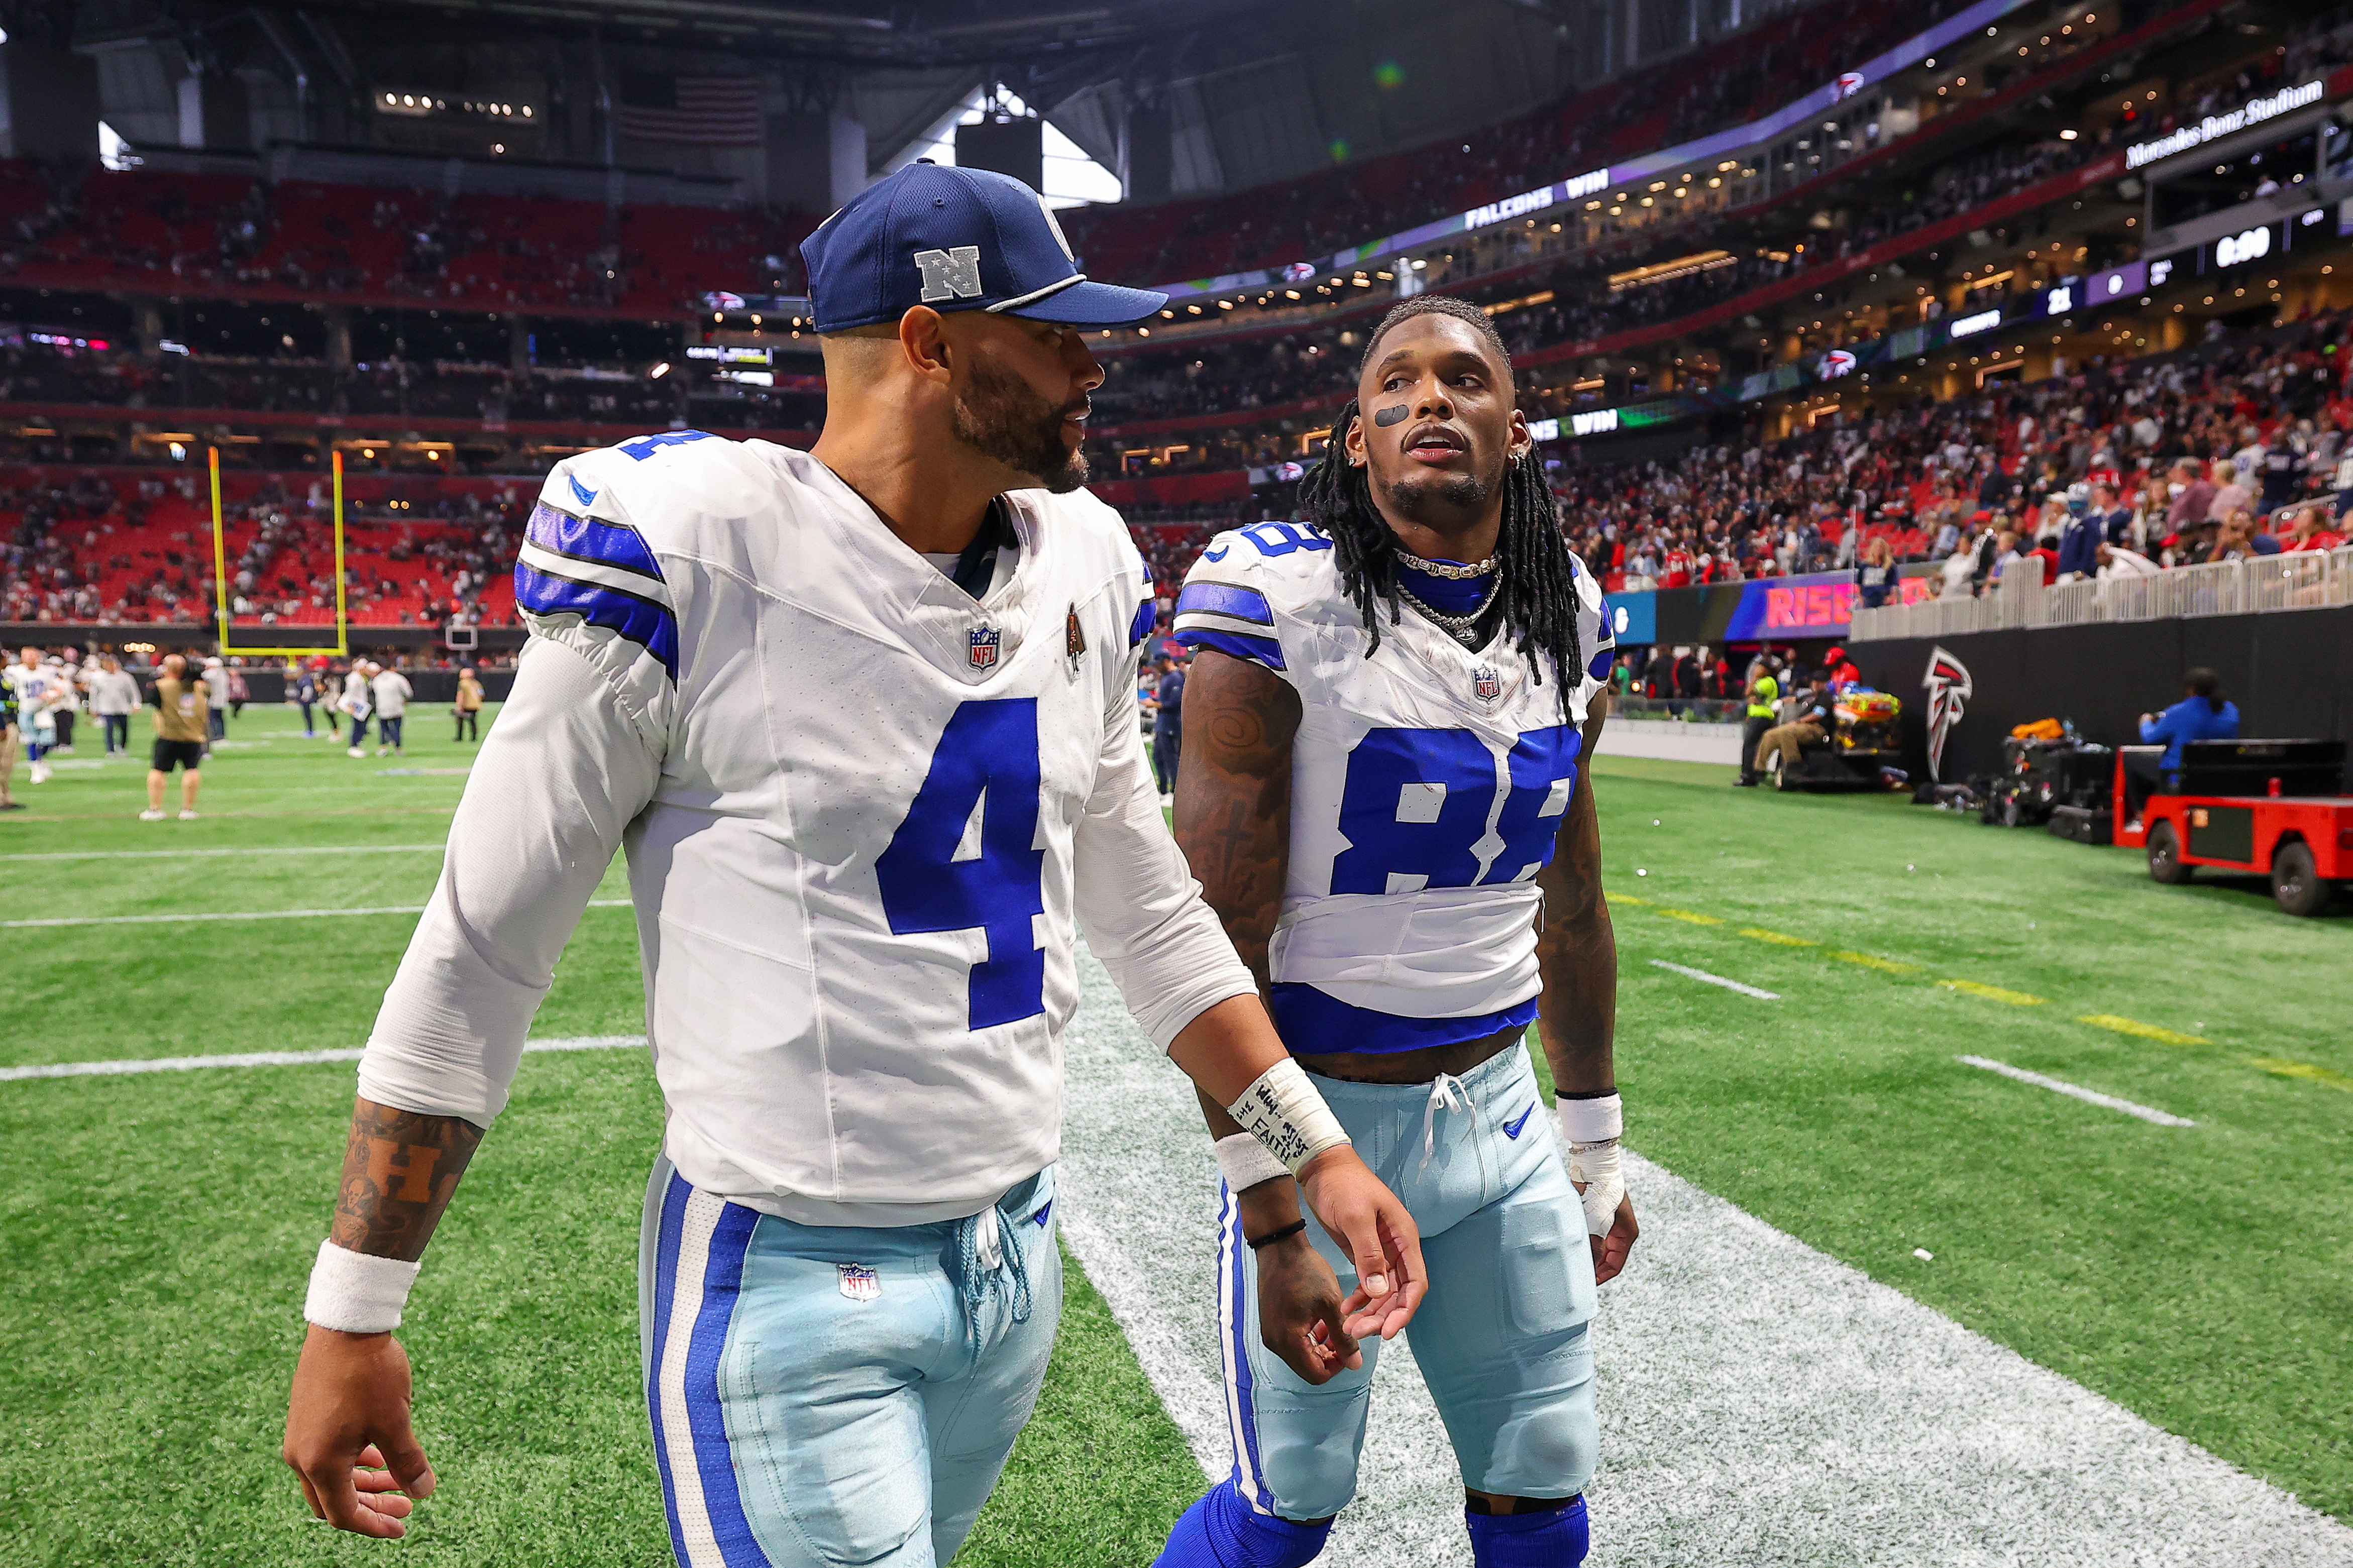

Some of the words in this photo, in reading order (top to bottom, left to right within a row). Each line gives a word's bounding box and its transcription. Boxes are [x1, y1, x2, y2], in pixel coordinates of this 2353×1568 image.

[1464, 185, 1554, 232] FALCONS
[1565, 167, 1610, 199] WIN
[1571, 408, 1619, 436] WIN
[972, 645, 995, 665] NFL
[1477, 682, 1498, 697] NFL
[1329, 725, 1582, 895] 88
[875, 697, 1046, 1031] 4
[1251, 1116, 1291, 1161] FAITH
